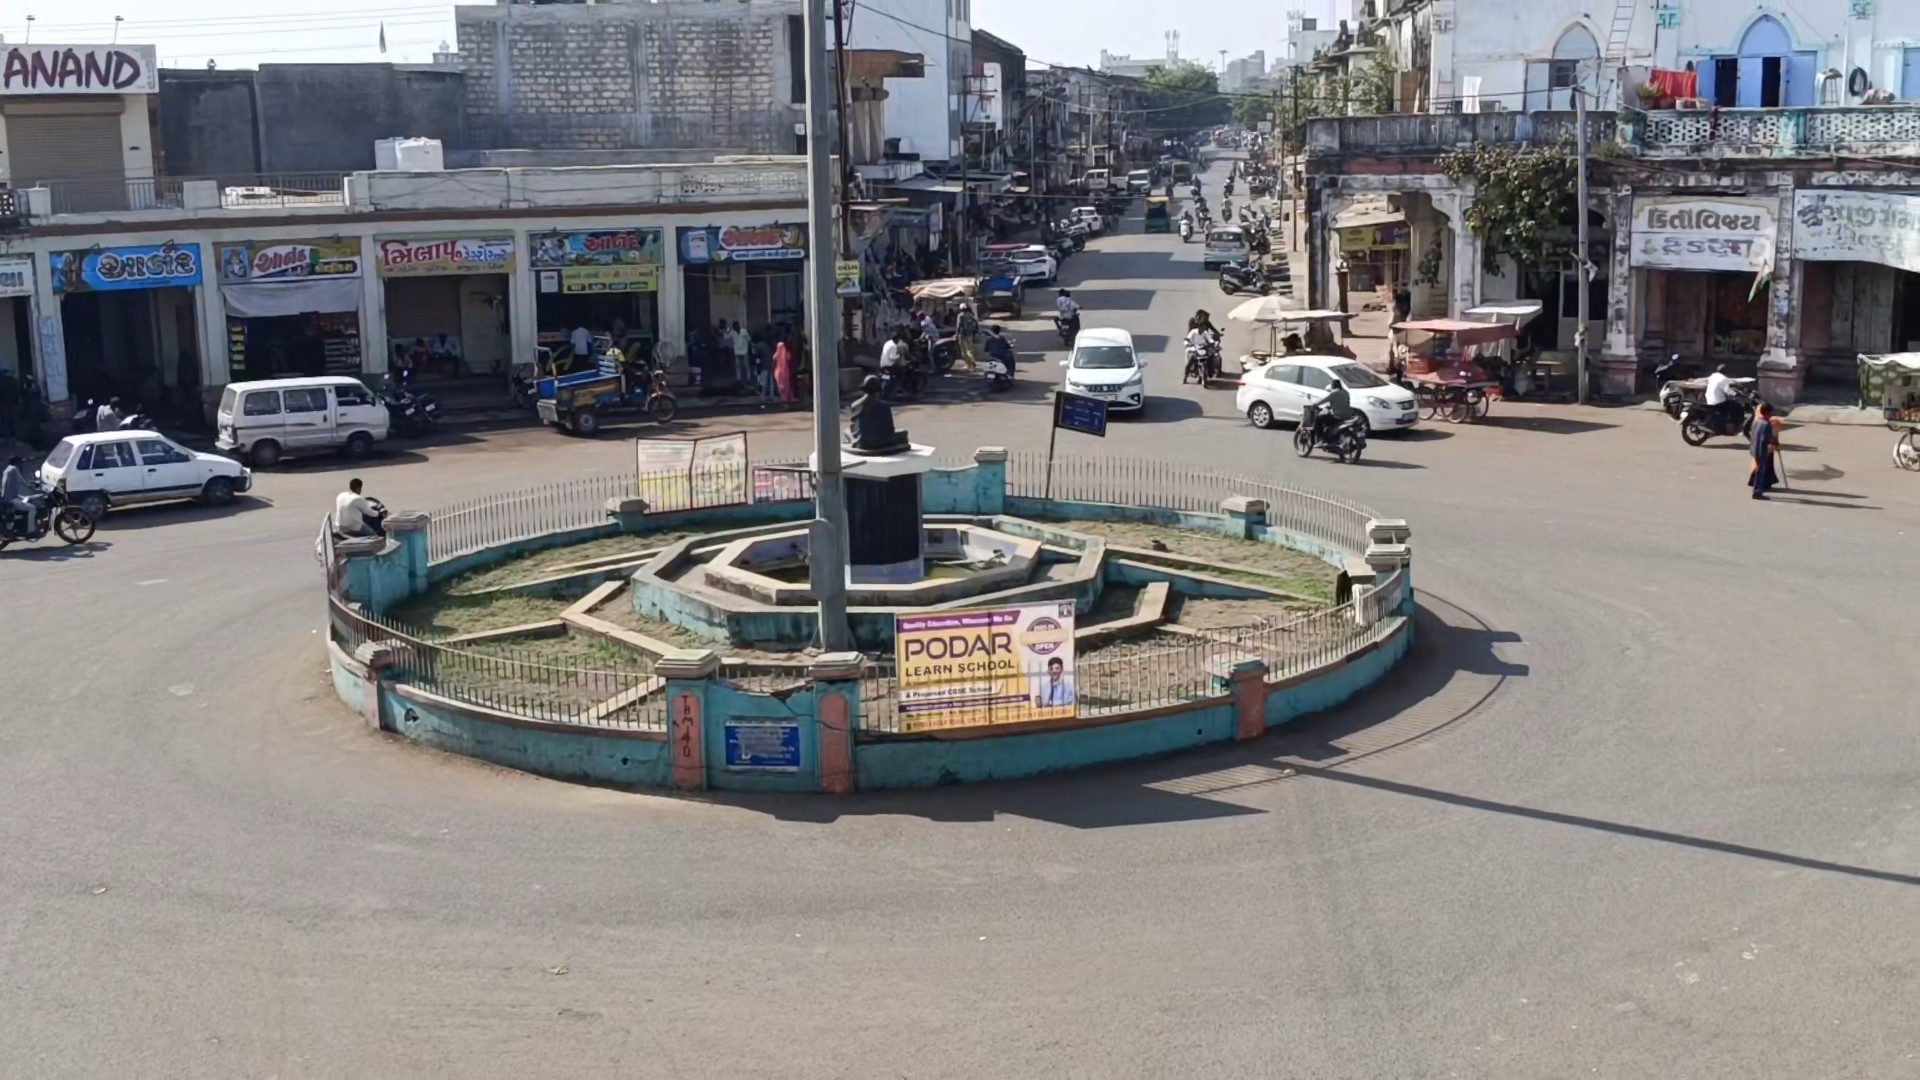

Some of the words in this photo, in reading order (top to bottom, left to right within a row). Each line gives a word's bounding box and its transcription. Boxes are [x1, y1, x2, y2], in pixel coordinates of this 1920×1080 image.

[3, 47, 141, 90] ANAND
[904, 632, 1013, 662] PODAR
[905, 664, 953, 677] LEARN
[958, 659, 1015, 673] SCHOOL
